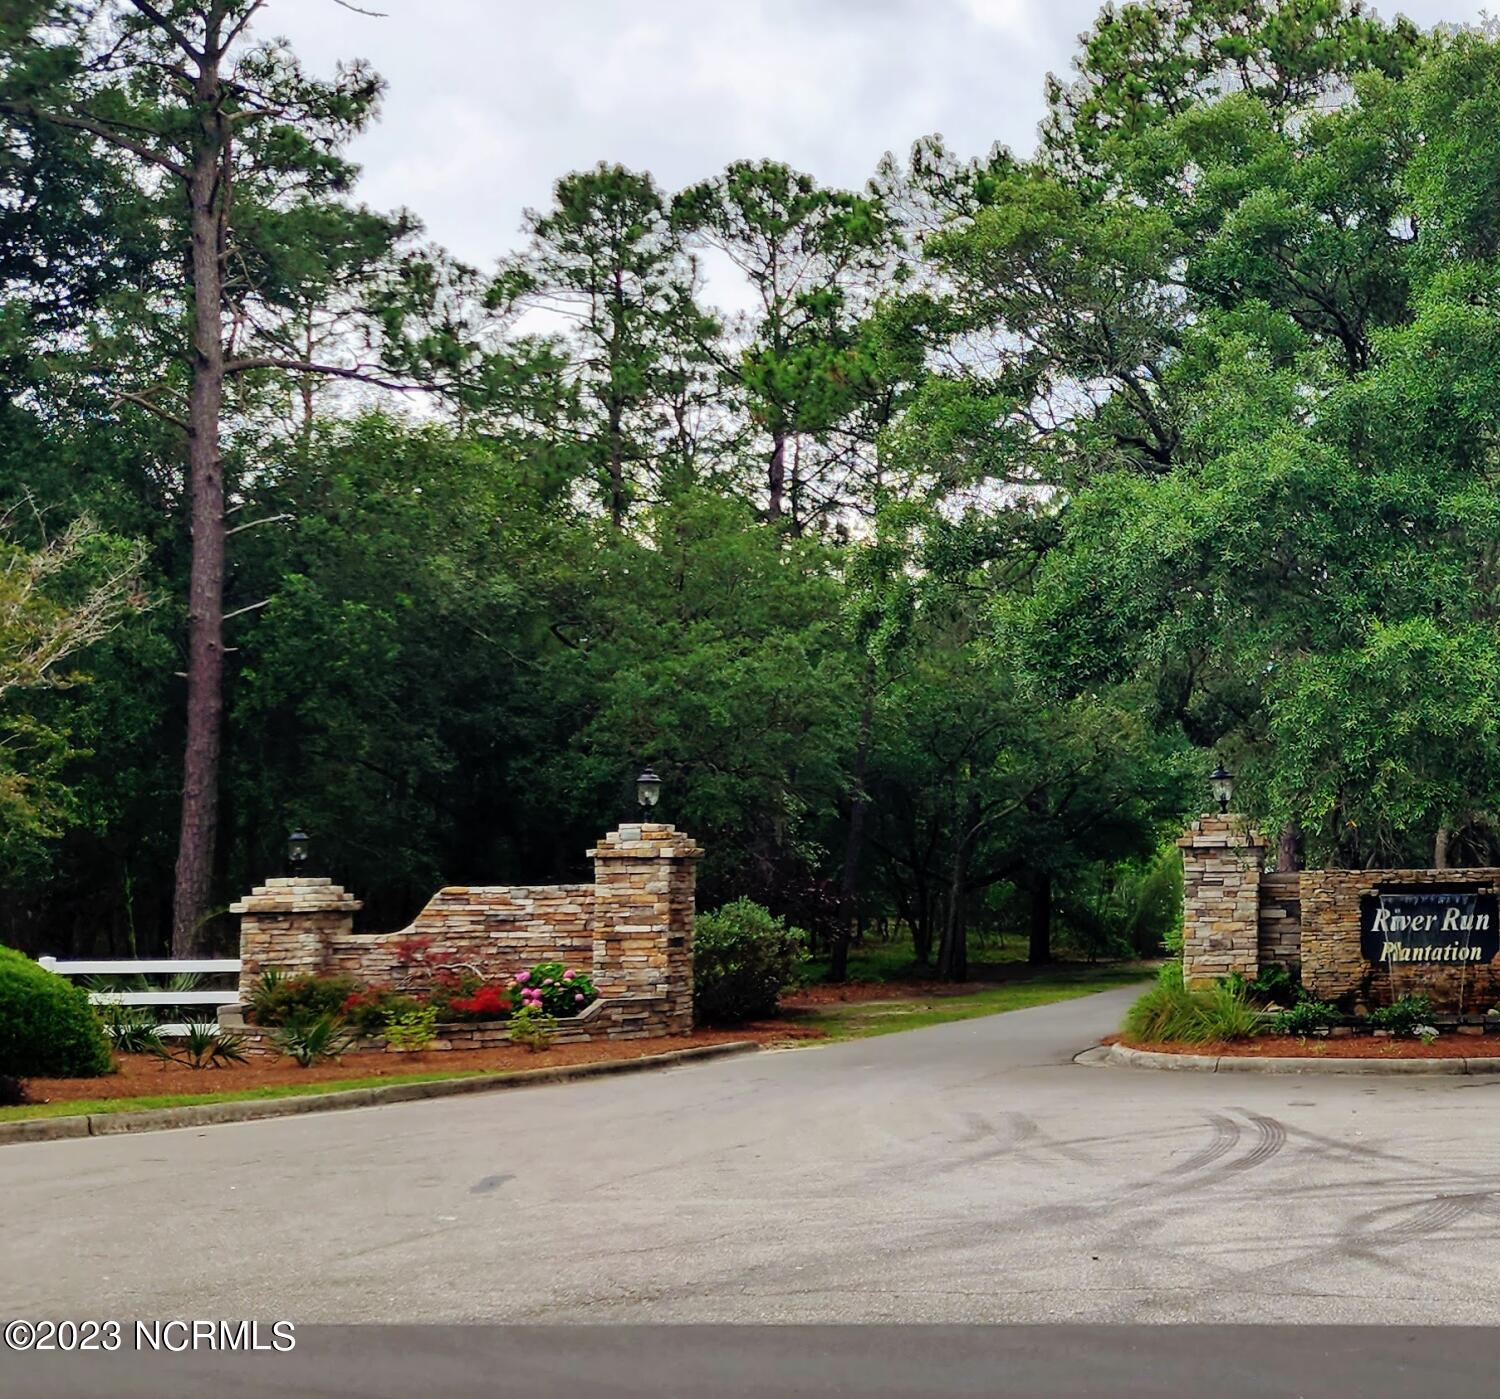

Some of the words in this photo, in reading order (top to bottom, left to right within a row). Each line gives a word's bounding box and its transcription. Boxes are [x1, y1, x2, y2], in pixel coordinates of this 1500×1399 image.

[1371, 908, 1437, 932] River
[1440, 907, 1490, 931] Run
[1379, 941, 1482, 962] Plantation
